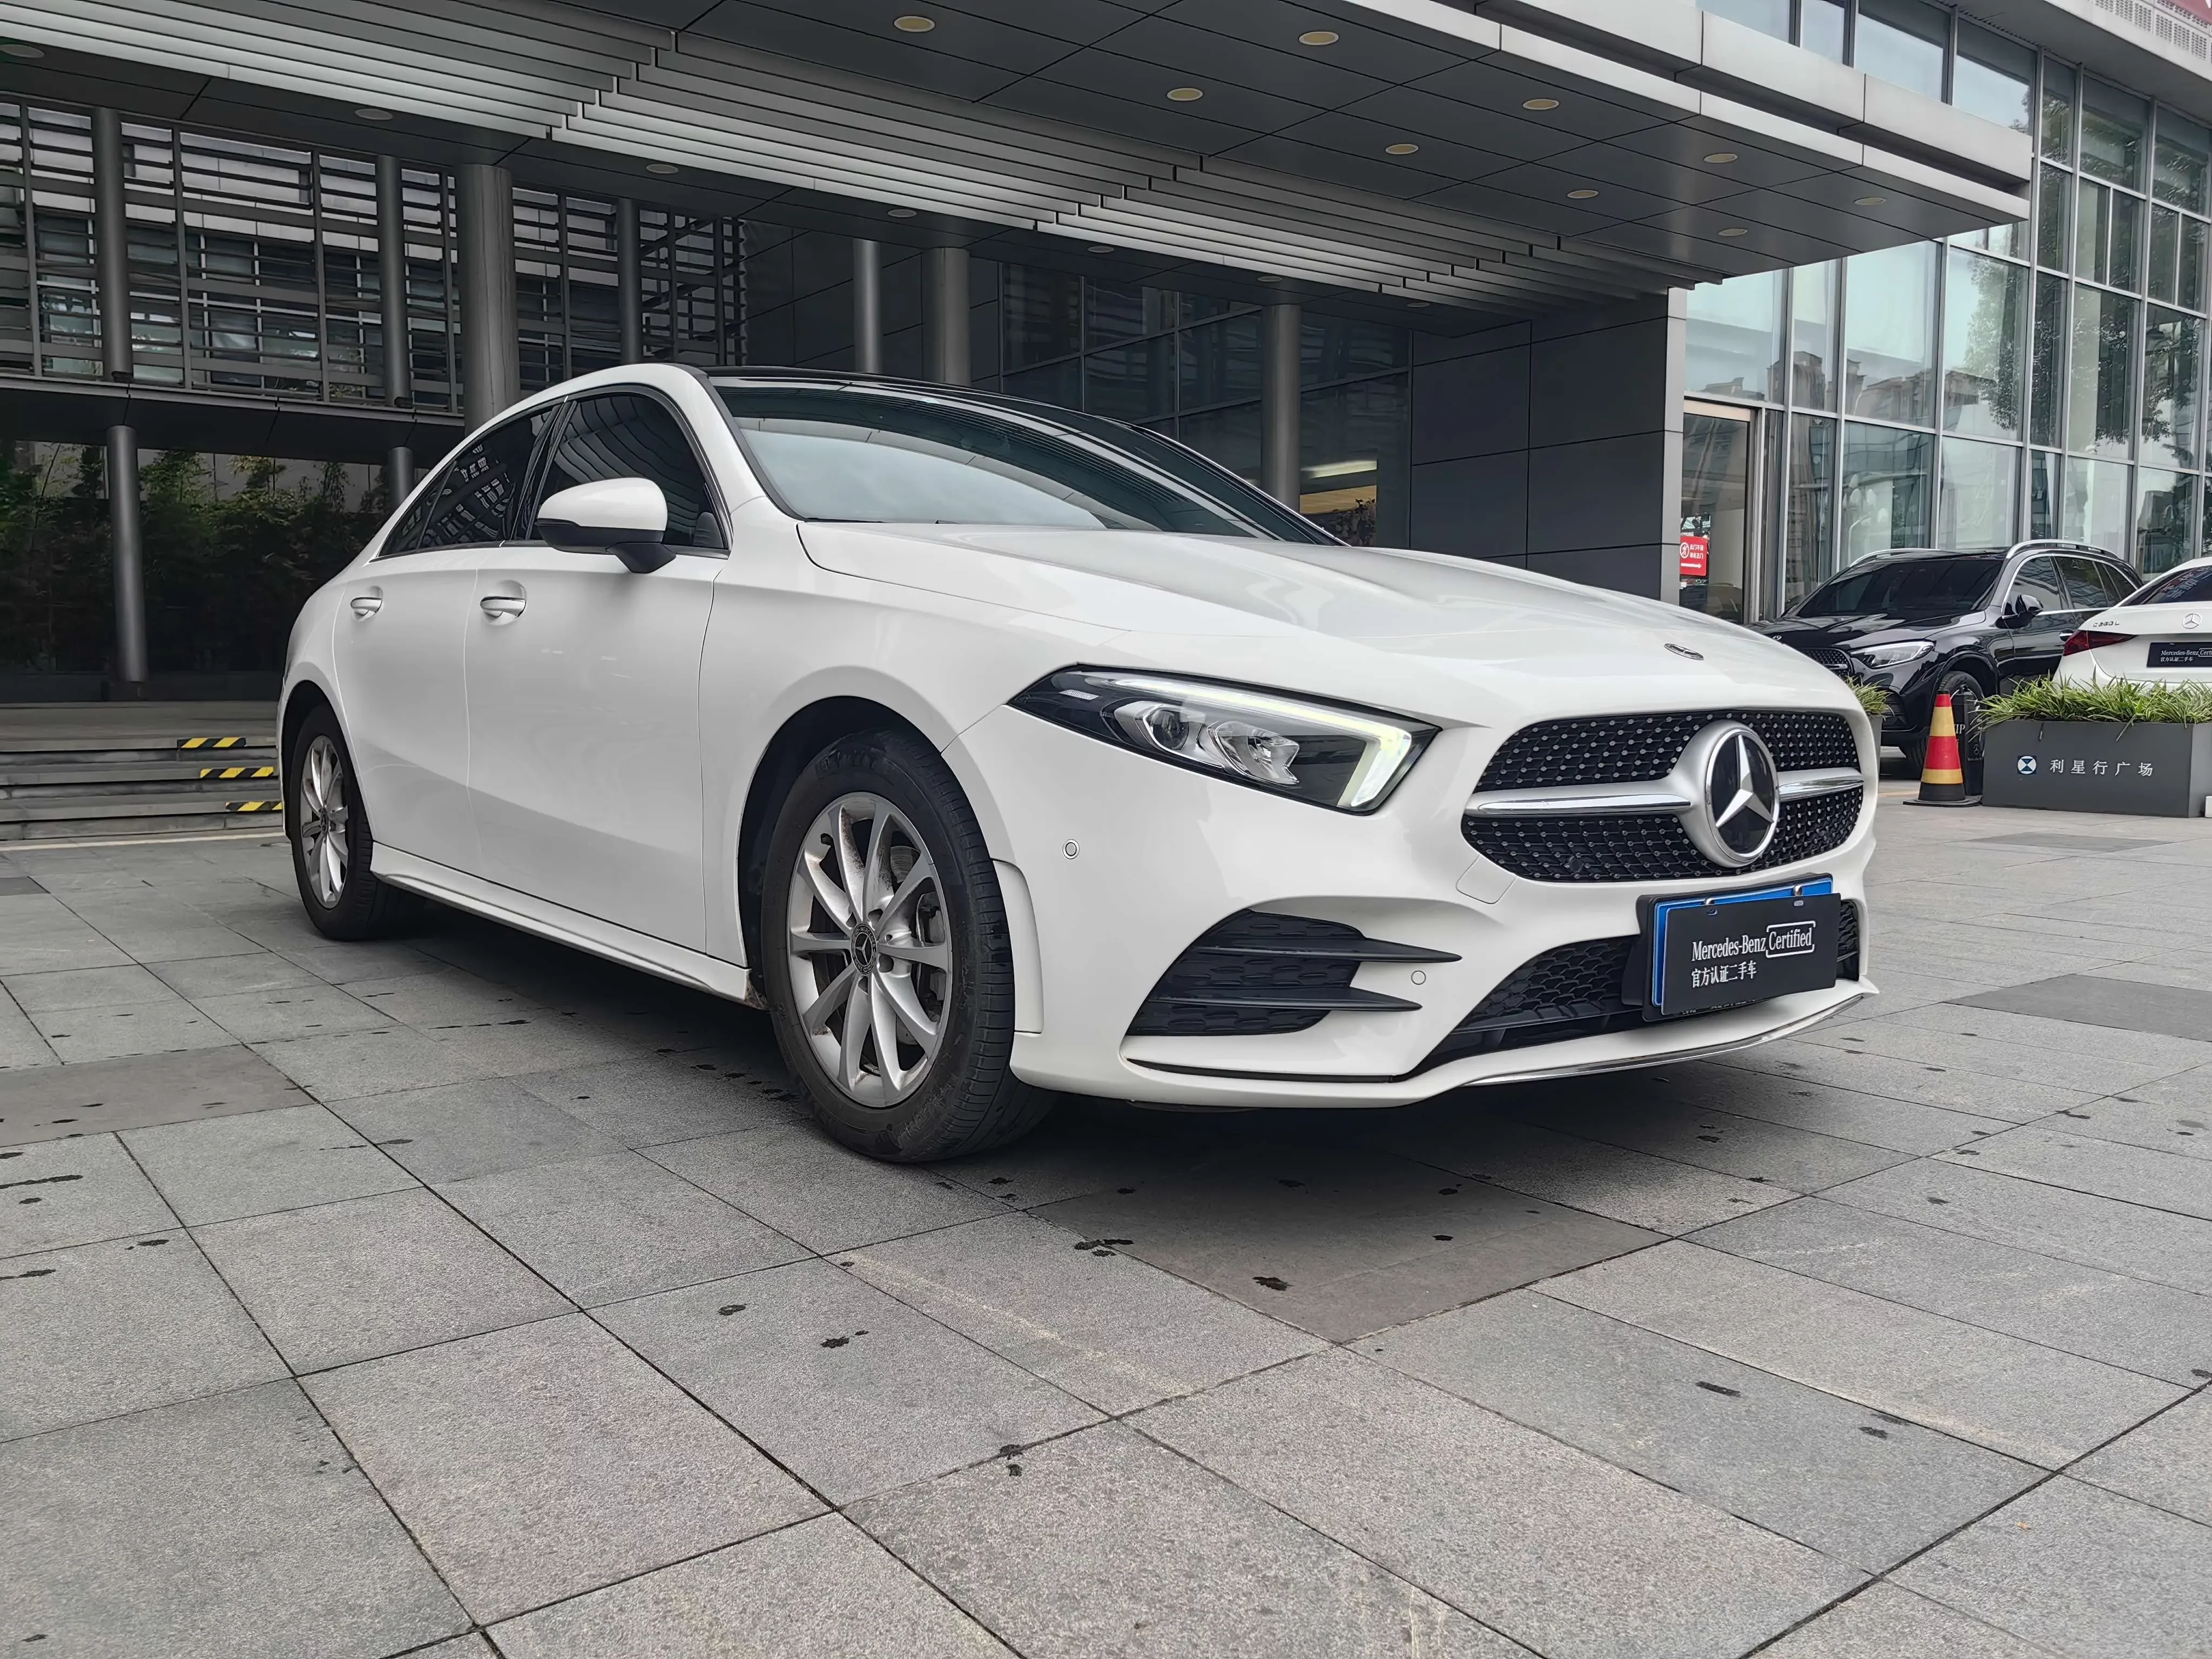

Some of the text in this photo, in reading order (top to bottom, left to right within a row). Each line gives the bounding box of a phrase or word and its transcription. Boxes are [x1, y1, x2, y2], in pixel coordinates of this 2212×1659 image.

[1954, 724, 1966, 734] IP
[2049, 759, 2153, 777] 利星行广场
[1691, 927, 1812, 961] Mercedes-Benz Certified
[1691, 960, 1757, 988] 官方认证二手车
